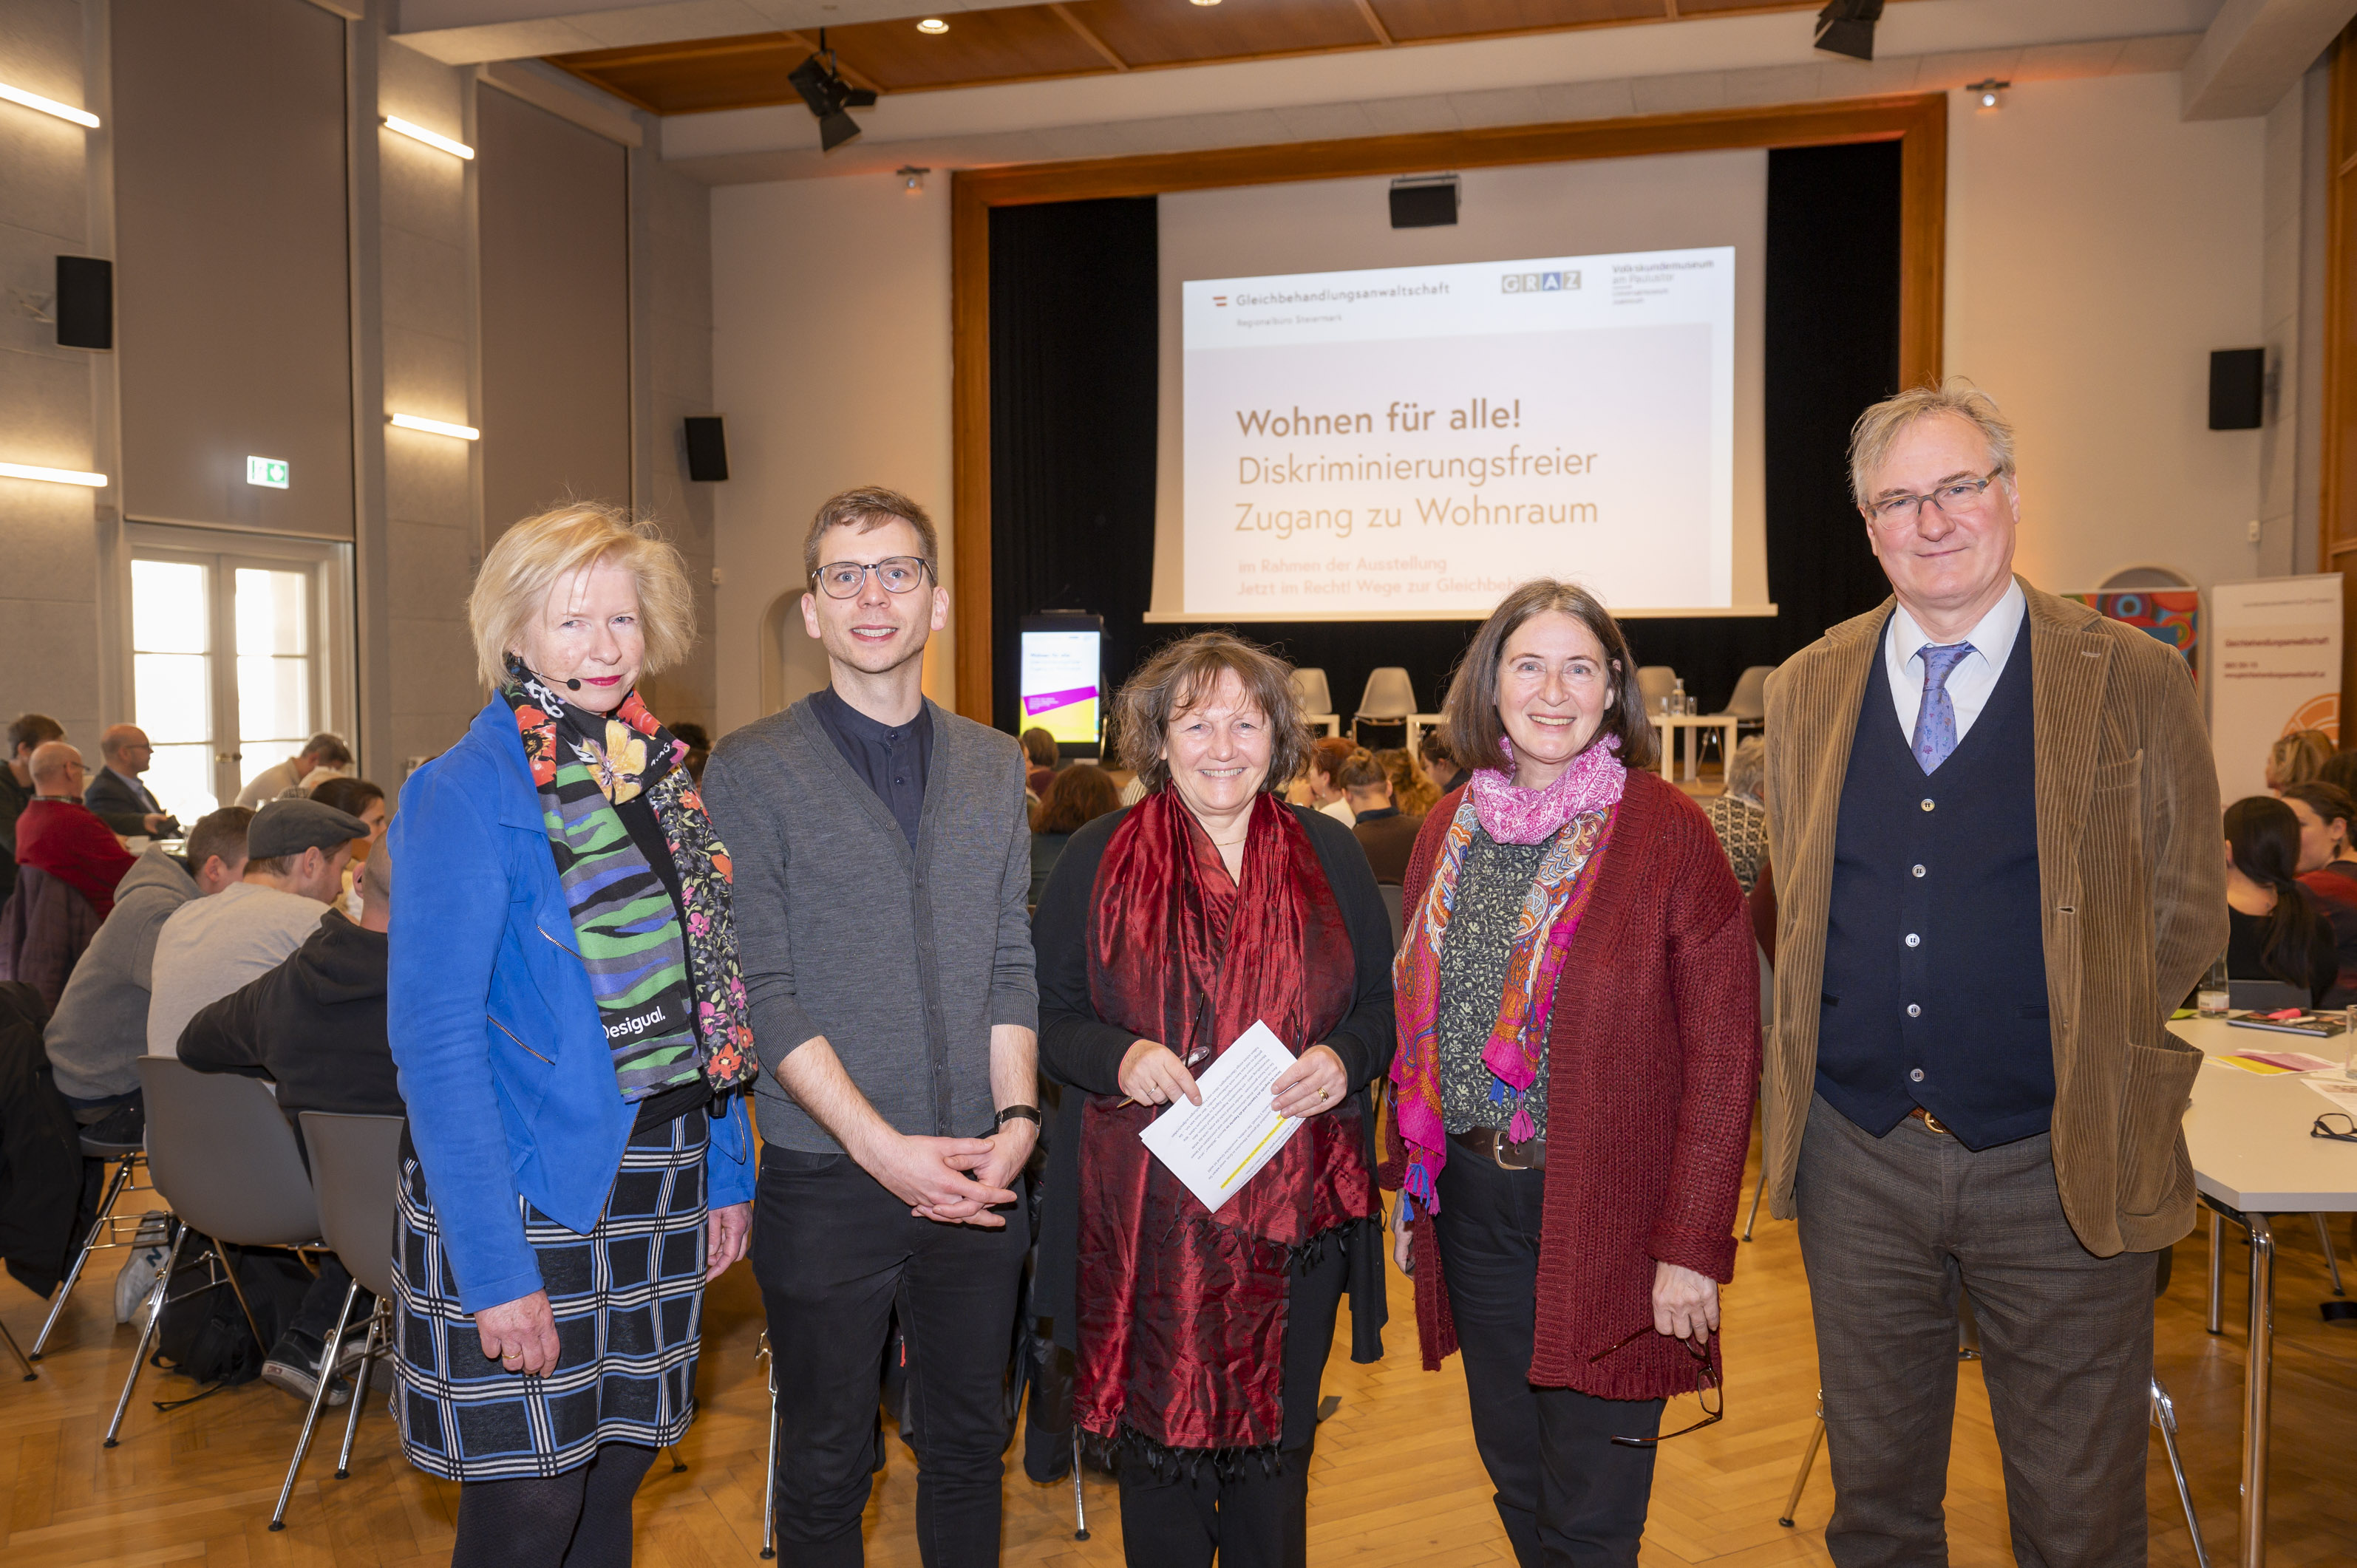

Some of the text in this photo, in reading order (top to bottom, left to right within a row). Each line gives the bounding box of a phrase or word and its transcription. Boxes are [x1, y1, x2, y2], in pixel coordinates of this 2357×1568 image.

[1502, 270, 1580, 293] GRAZ
[1236, 282, 1450, 306] Gleichbehandlungsanwaltschaft
[1296, 314, 1342, 325] Steiermark
[1236, 398, 1521, 437] Wohnen für alle!
[1239, 444, 1598, 487] Diskriminierungsfreier
[1235, 494, 1598, 539] Zugang zu Wohnraum
[1239, 556, 1446, 574] im Rahmen der Ausstellung
[1237, 579, 1276, 596] Jetzt
[1281, 580, 1299, 594] im
[1304, 579, 1350, 595] Recht!
[1357, 579, 1401, 597] Wege
[1407, 580, 1431, 593] zur
